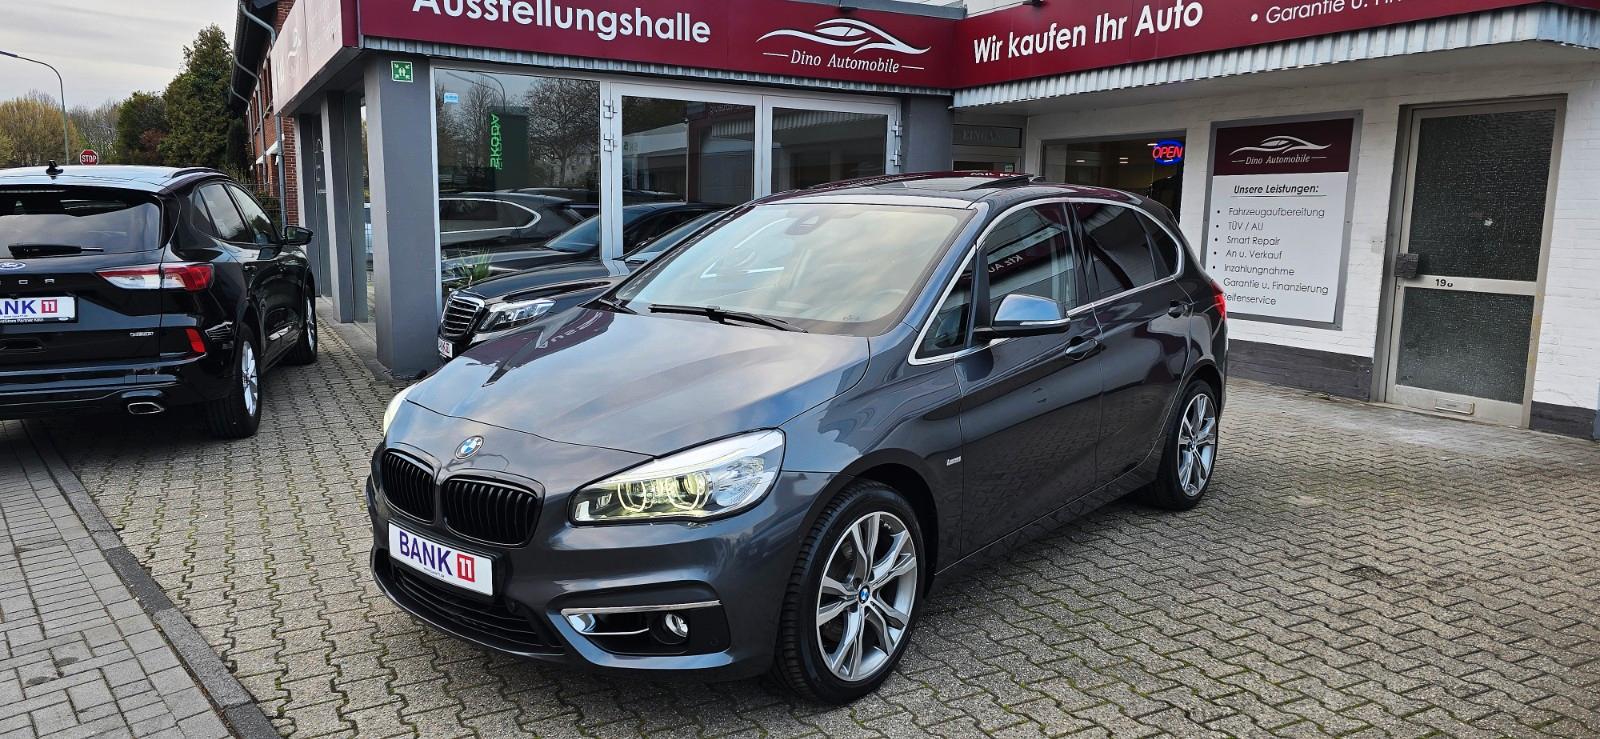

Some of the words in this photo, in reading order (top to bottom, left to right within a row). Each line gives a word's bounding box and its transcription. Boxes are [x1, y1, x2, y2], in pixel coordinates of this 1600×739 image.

[1265, 0, 1345, 24] Garantie
[973, 34, 1003, 64] Wir
[1008, 22, 1087, 59] kaufen
[1094, 12, 1128, 44] Ihr
[1134, 0, 1204, 37] Auto
[790, 49, 822, 66] Dino
[827, 53, 900, 74] Automobile
[81, 154, 97, 163] STOP
[1152, 145, 1184, 159] OPEN
[1245, 156, 1263, 165] Dino
[1265, 153, 1311, 165] Automobile
[1234, 185, 1263, 194] Unsere
[1265, 184, 1319, 196] Leistungen:
[1228, 207, 1325, 218] Fahrzeugaufbereitung
[1228, 221, 1243, 231] TÜV
[1251, 222, 1264, 231] AU
[1226, 235, 1250, 245] Smart
[1252, 236, 1280, 246] Repair
[1225, 249, 1237, 257] An
[1249, 250, 1283, 260] Verkauf
[1224, 263, 1295, 276] Inzahlungnahme
[1223, 277, 1260, 289] Garantie
[1262, 282, 1270, 290] u.
[1272, 281, 1329, 295] Finanzierung
[42, 299, 57, 313] 11
[399, 530, 453, 576] BANK
[458, 554, 474, 581] 11
